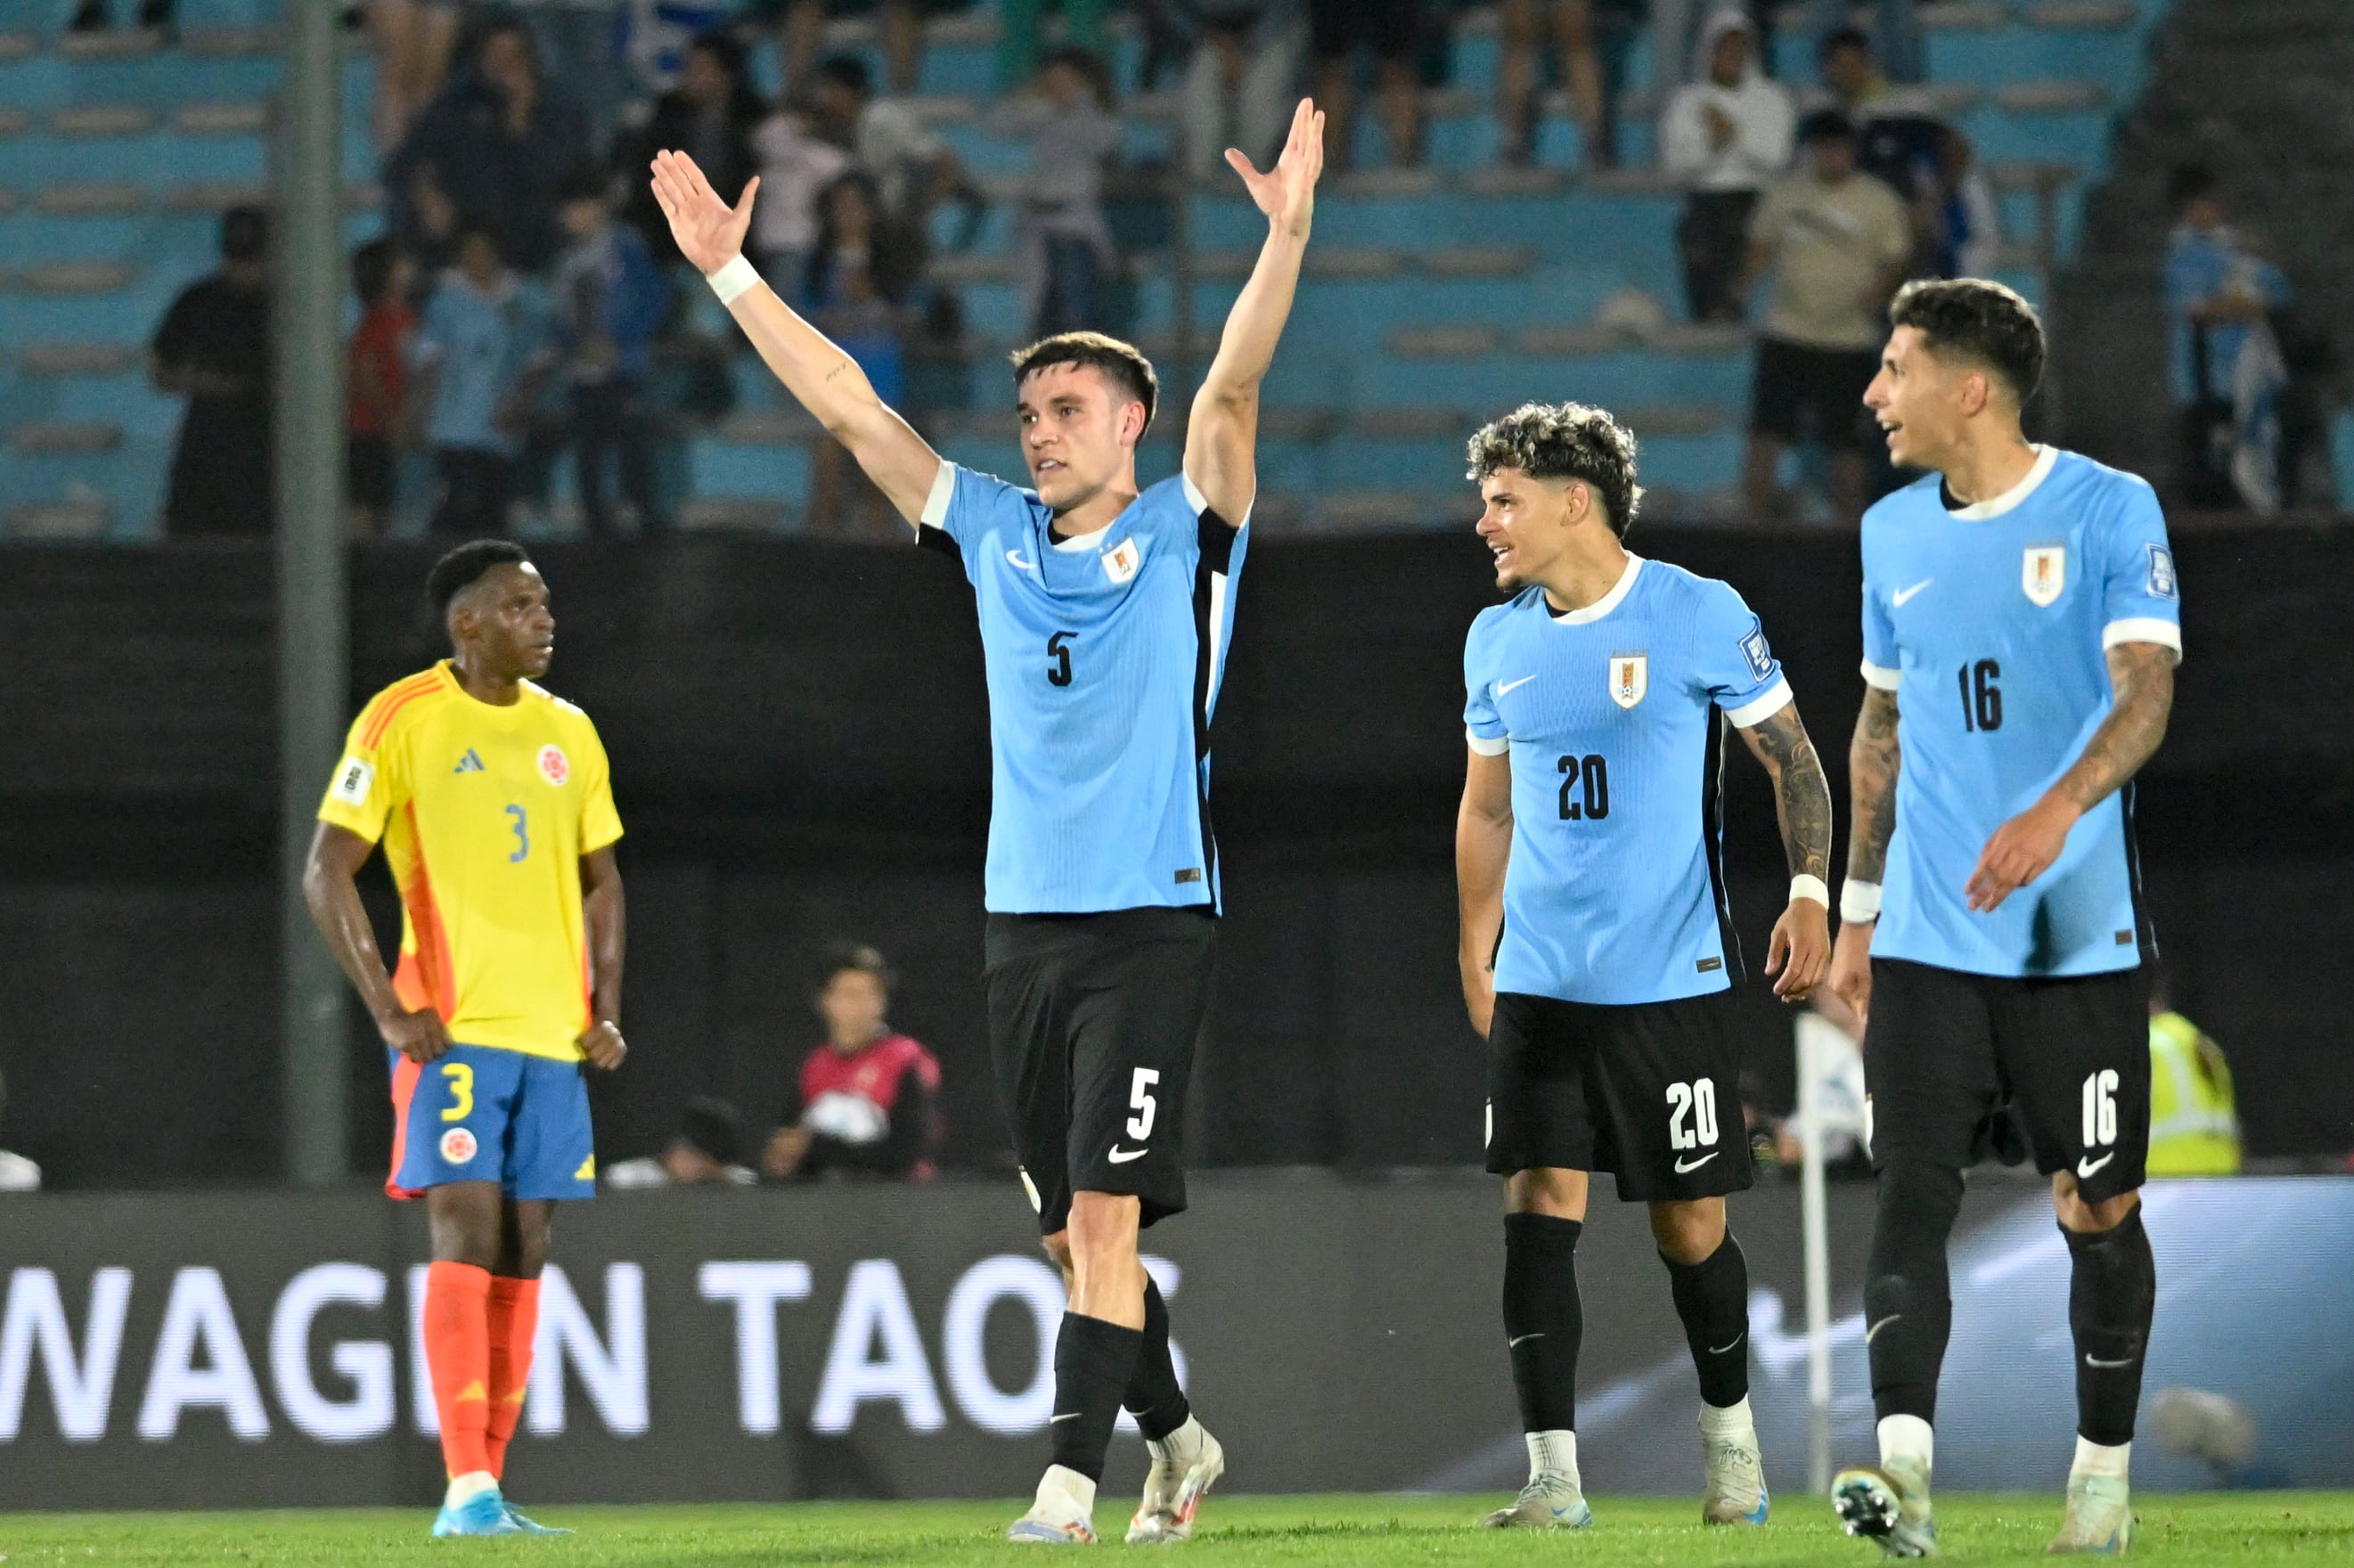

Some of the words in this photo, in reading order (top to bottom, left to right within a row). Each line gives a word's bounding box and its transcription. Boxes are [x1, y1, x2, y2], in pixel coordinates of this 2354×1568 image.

[1047, 631, 1078, 687] 5
[1958, 658, 2003, 732] 16
[1557, 755, 1609, 821] 20
[505, 804, 529, 862] 3
[441, 1064, 473, 1121] 3
[1126, 1066, 1160, 1140] 5
[1665, 1077, 1720, 1149] 20
[2082, 1069, 2120, 1148] 16
[0, 1263, 650, 1441] WAGN
